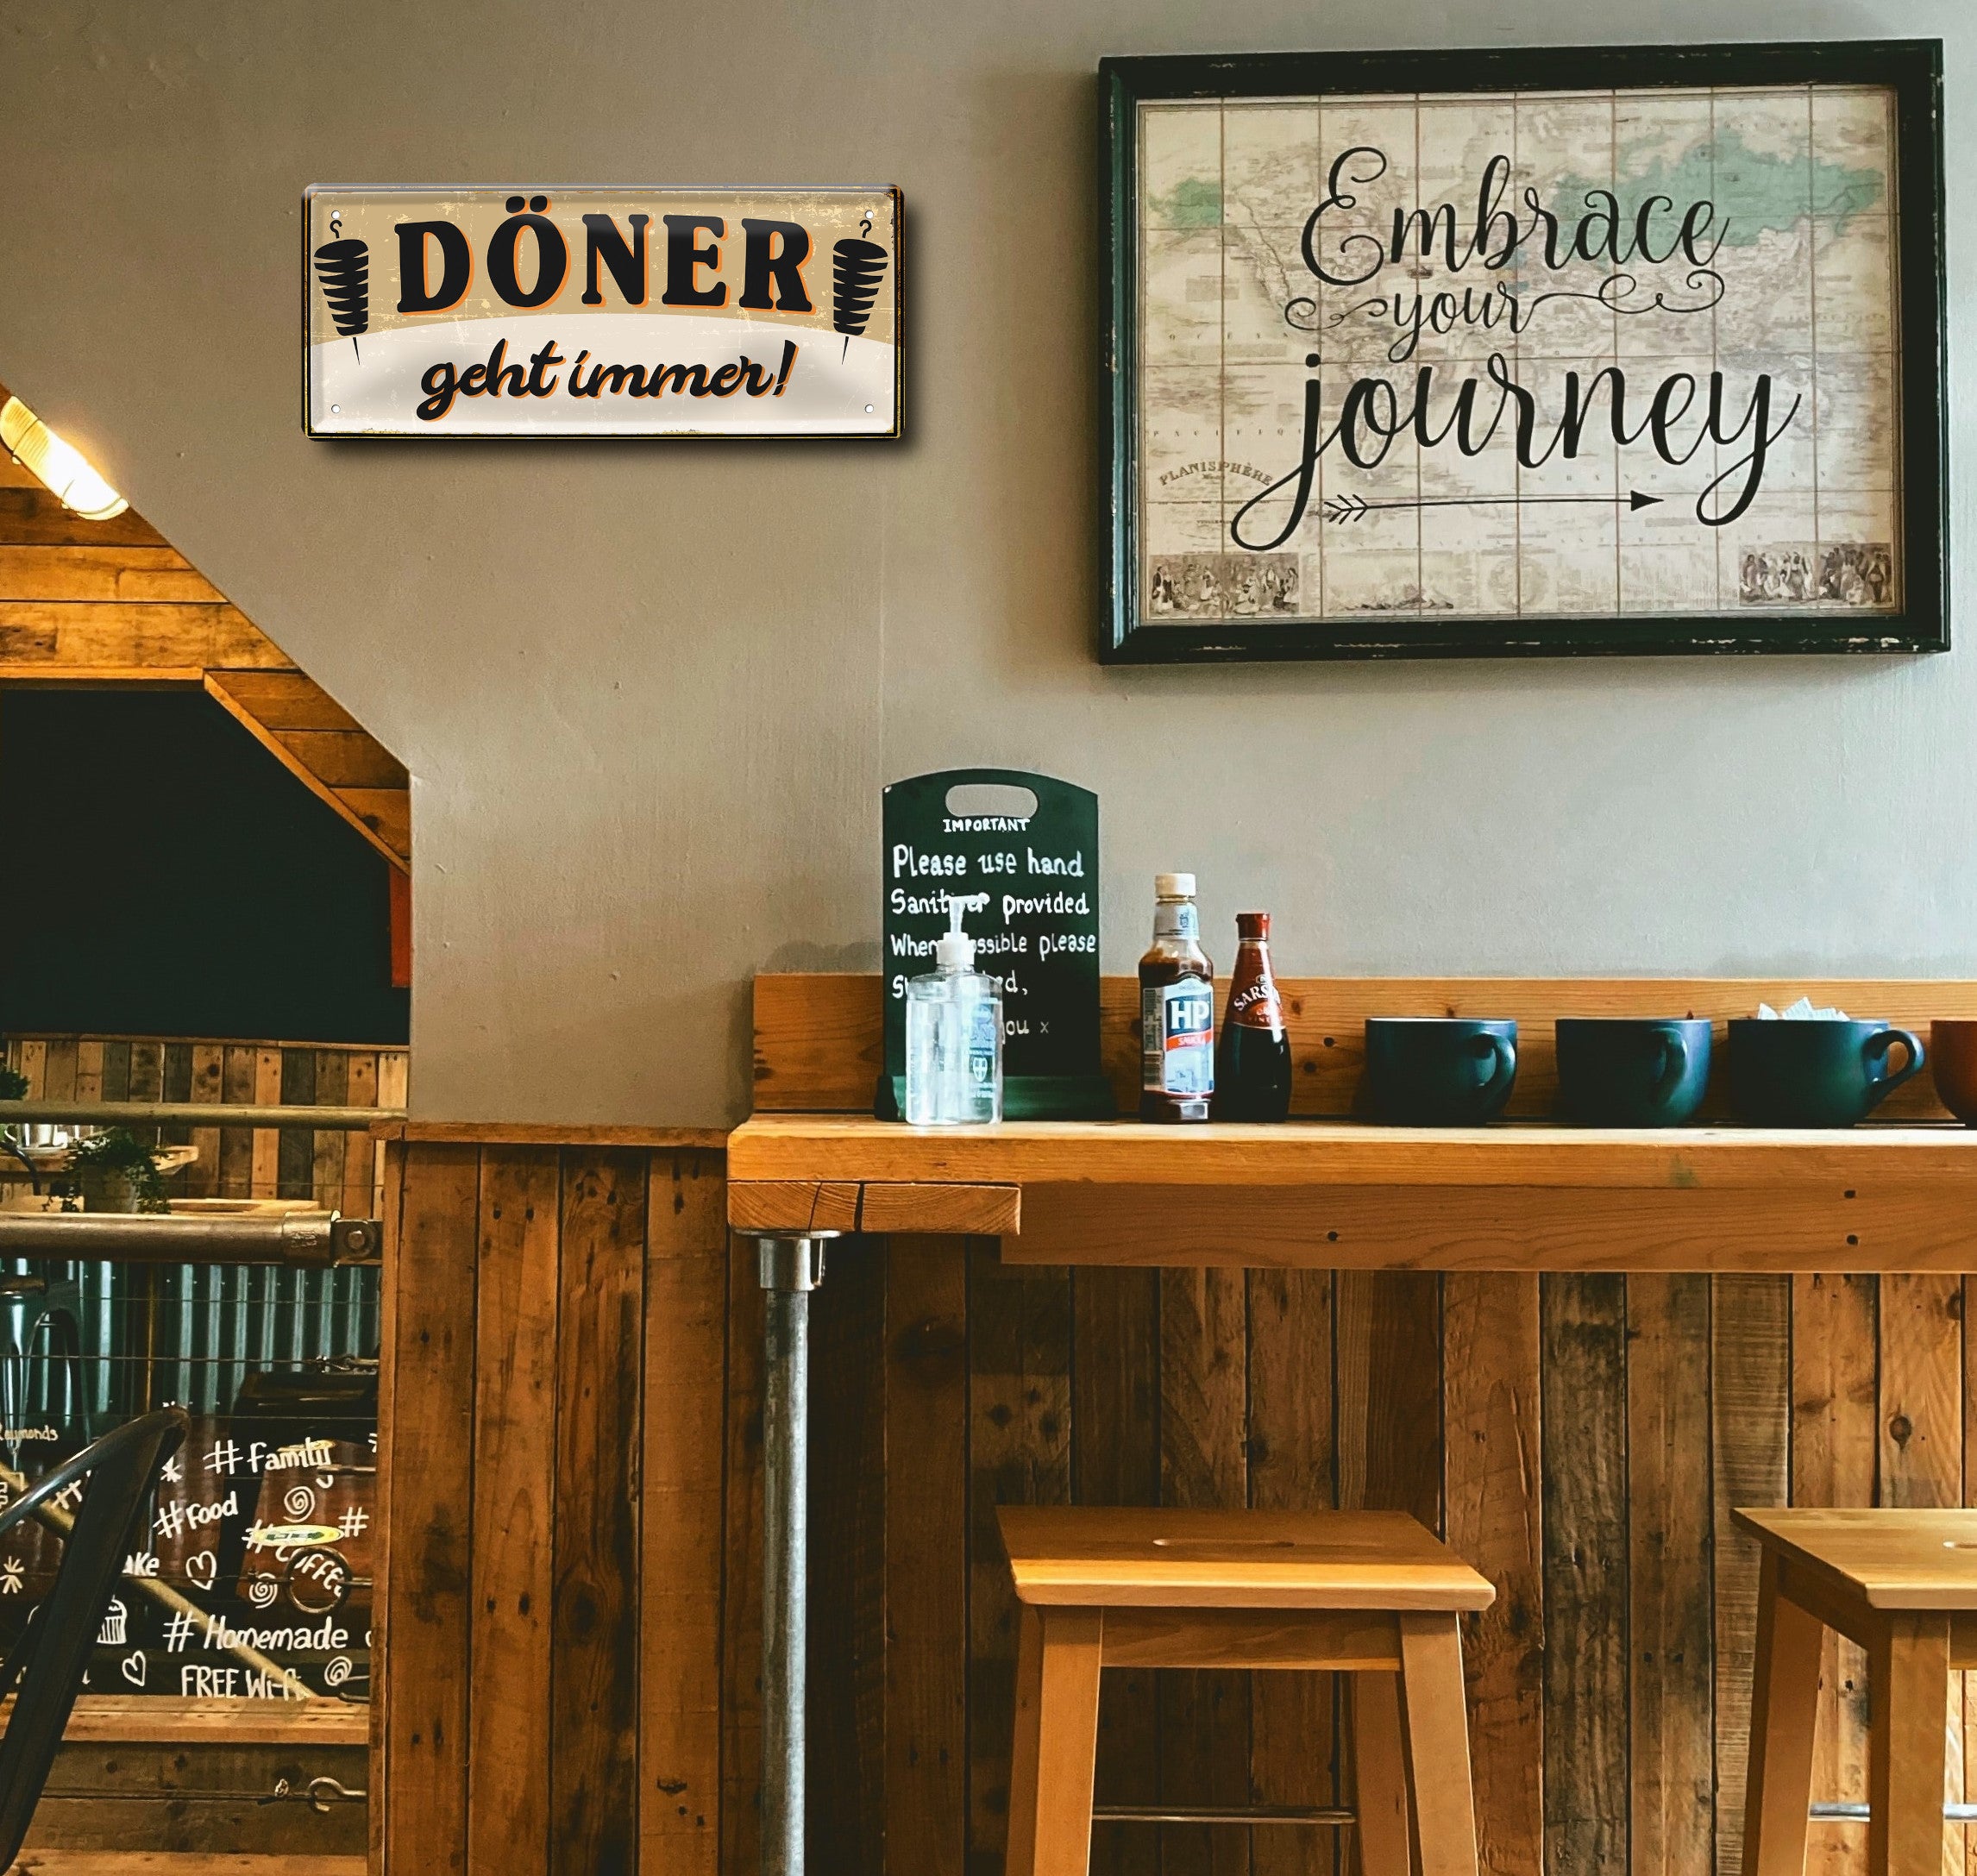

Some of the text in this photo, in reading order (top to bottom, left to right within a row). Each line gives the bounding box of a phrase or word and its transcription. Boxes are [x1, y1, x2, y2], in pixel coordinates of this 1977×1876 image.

[1299, 147, 1729, 286] Embrace
[394, 195, 817, 315] DÖNER
[416, 337, 799, 421] geht immer!
[1230, 352, 1803, 552] journey
[1159, 461, 1274, 486] PLANISPHÈRE
[943, 818, 1031, 832] IMPORTANT
[893, 844, 1084, 878] Please use hand
[890, 888, 1090, 925] Saniter provided
[1039, 932, 1096, 962] please
[1170, 1000, 1210, 1030] HP
[181, 1665, 239, 1699] FREE
